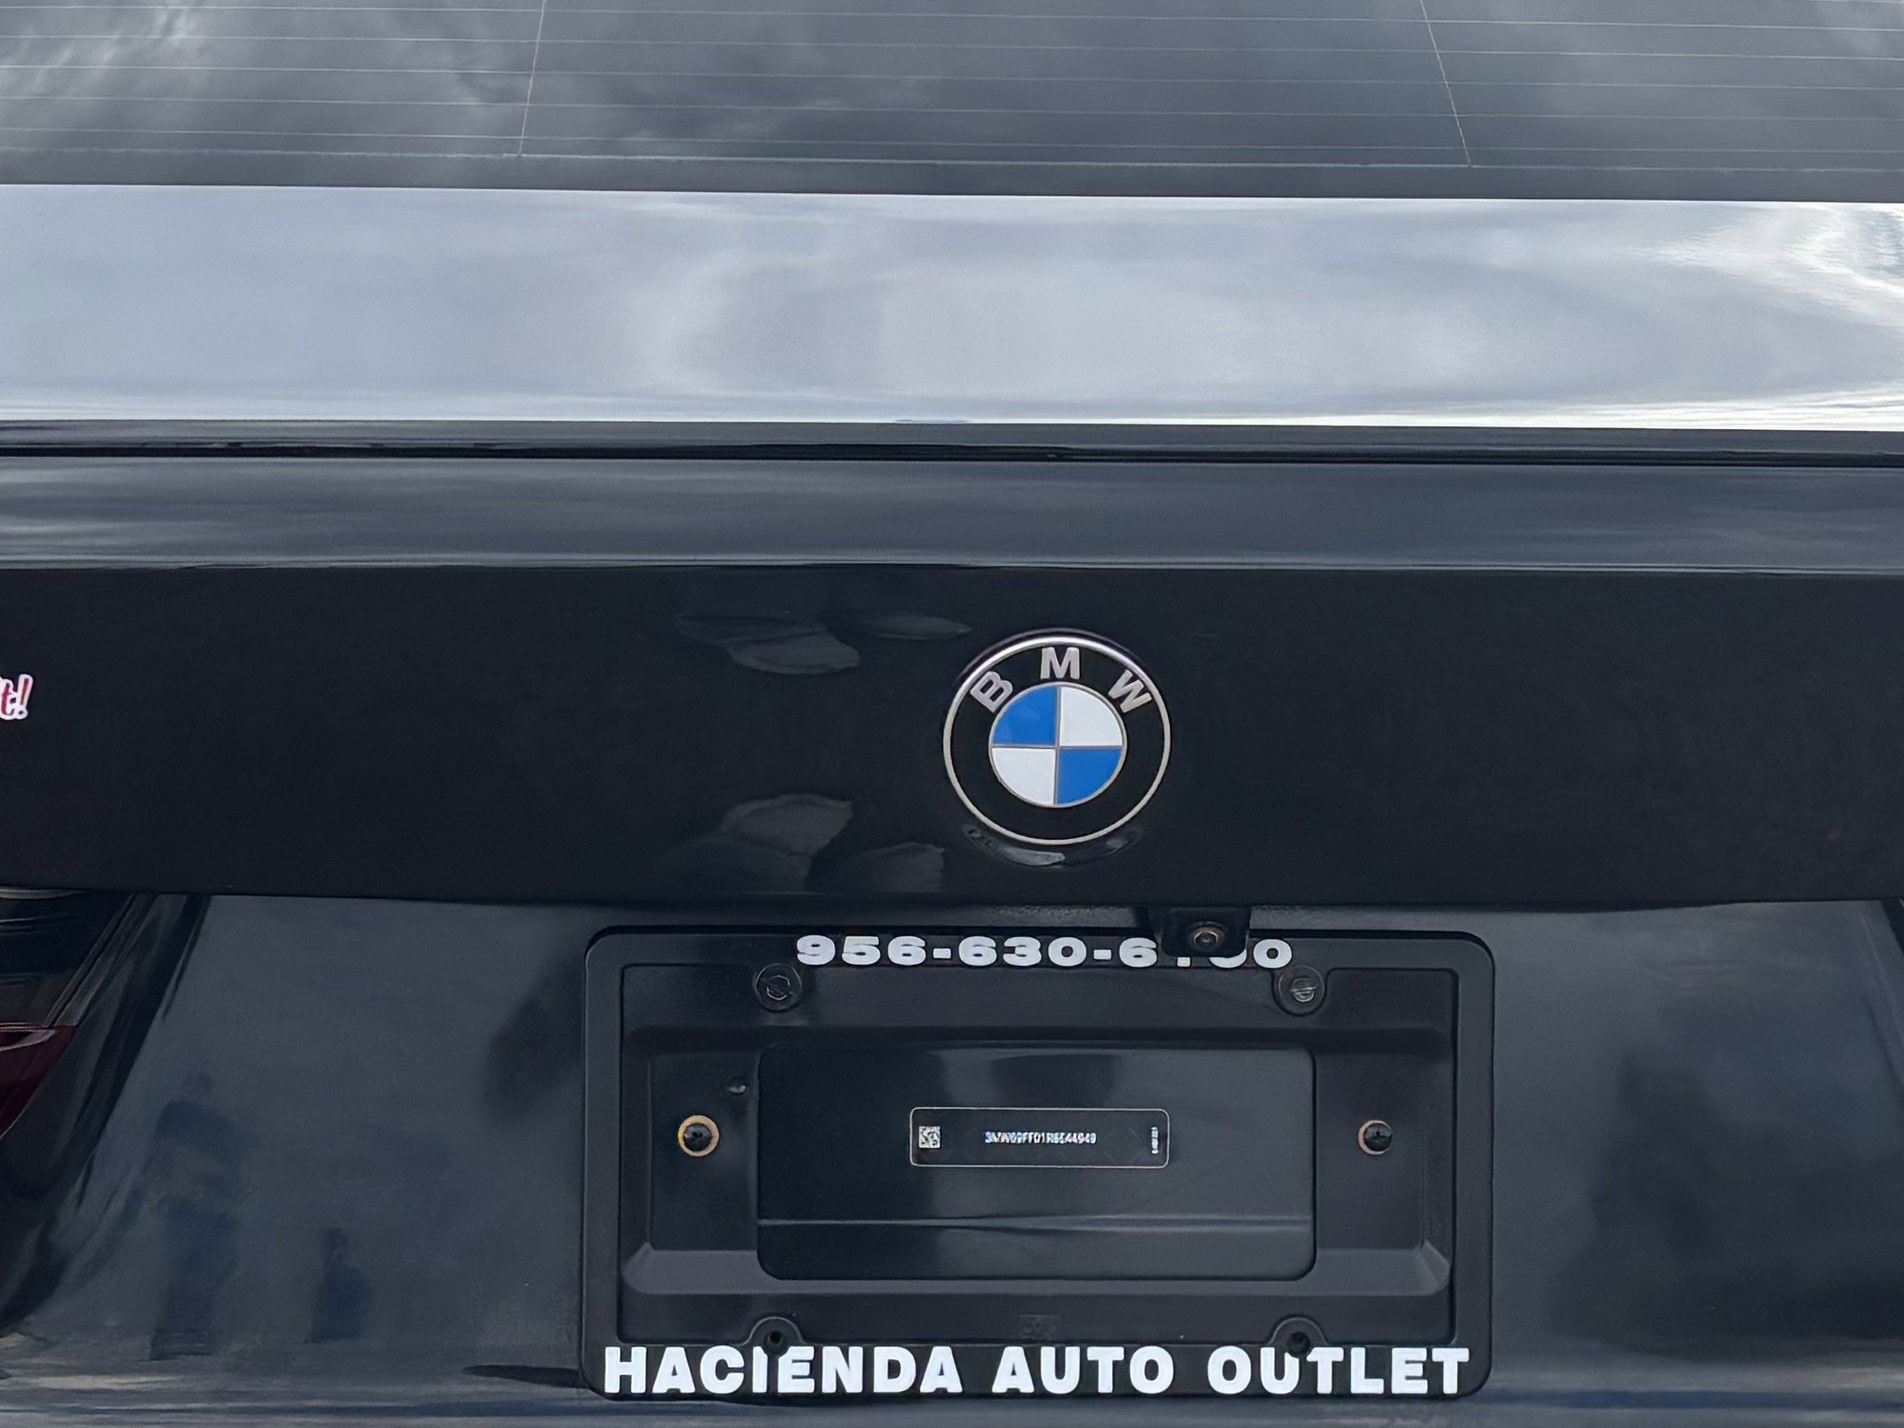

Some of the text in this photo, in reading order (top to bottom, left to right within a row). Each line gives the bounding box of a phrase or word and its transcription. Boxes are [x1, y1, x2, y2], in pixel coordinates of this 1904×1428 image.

[970, 646, 1153, 714] BMW
[796, 934, 1293, 969] 956-630-60
[603, 1344, 1470, 1396] HACIENDA AUTO OUTLET
